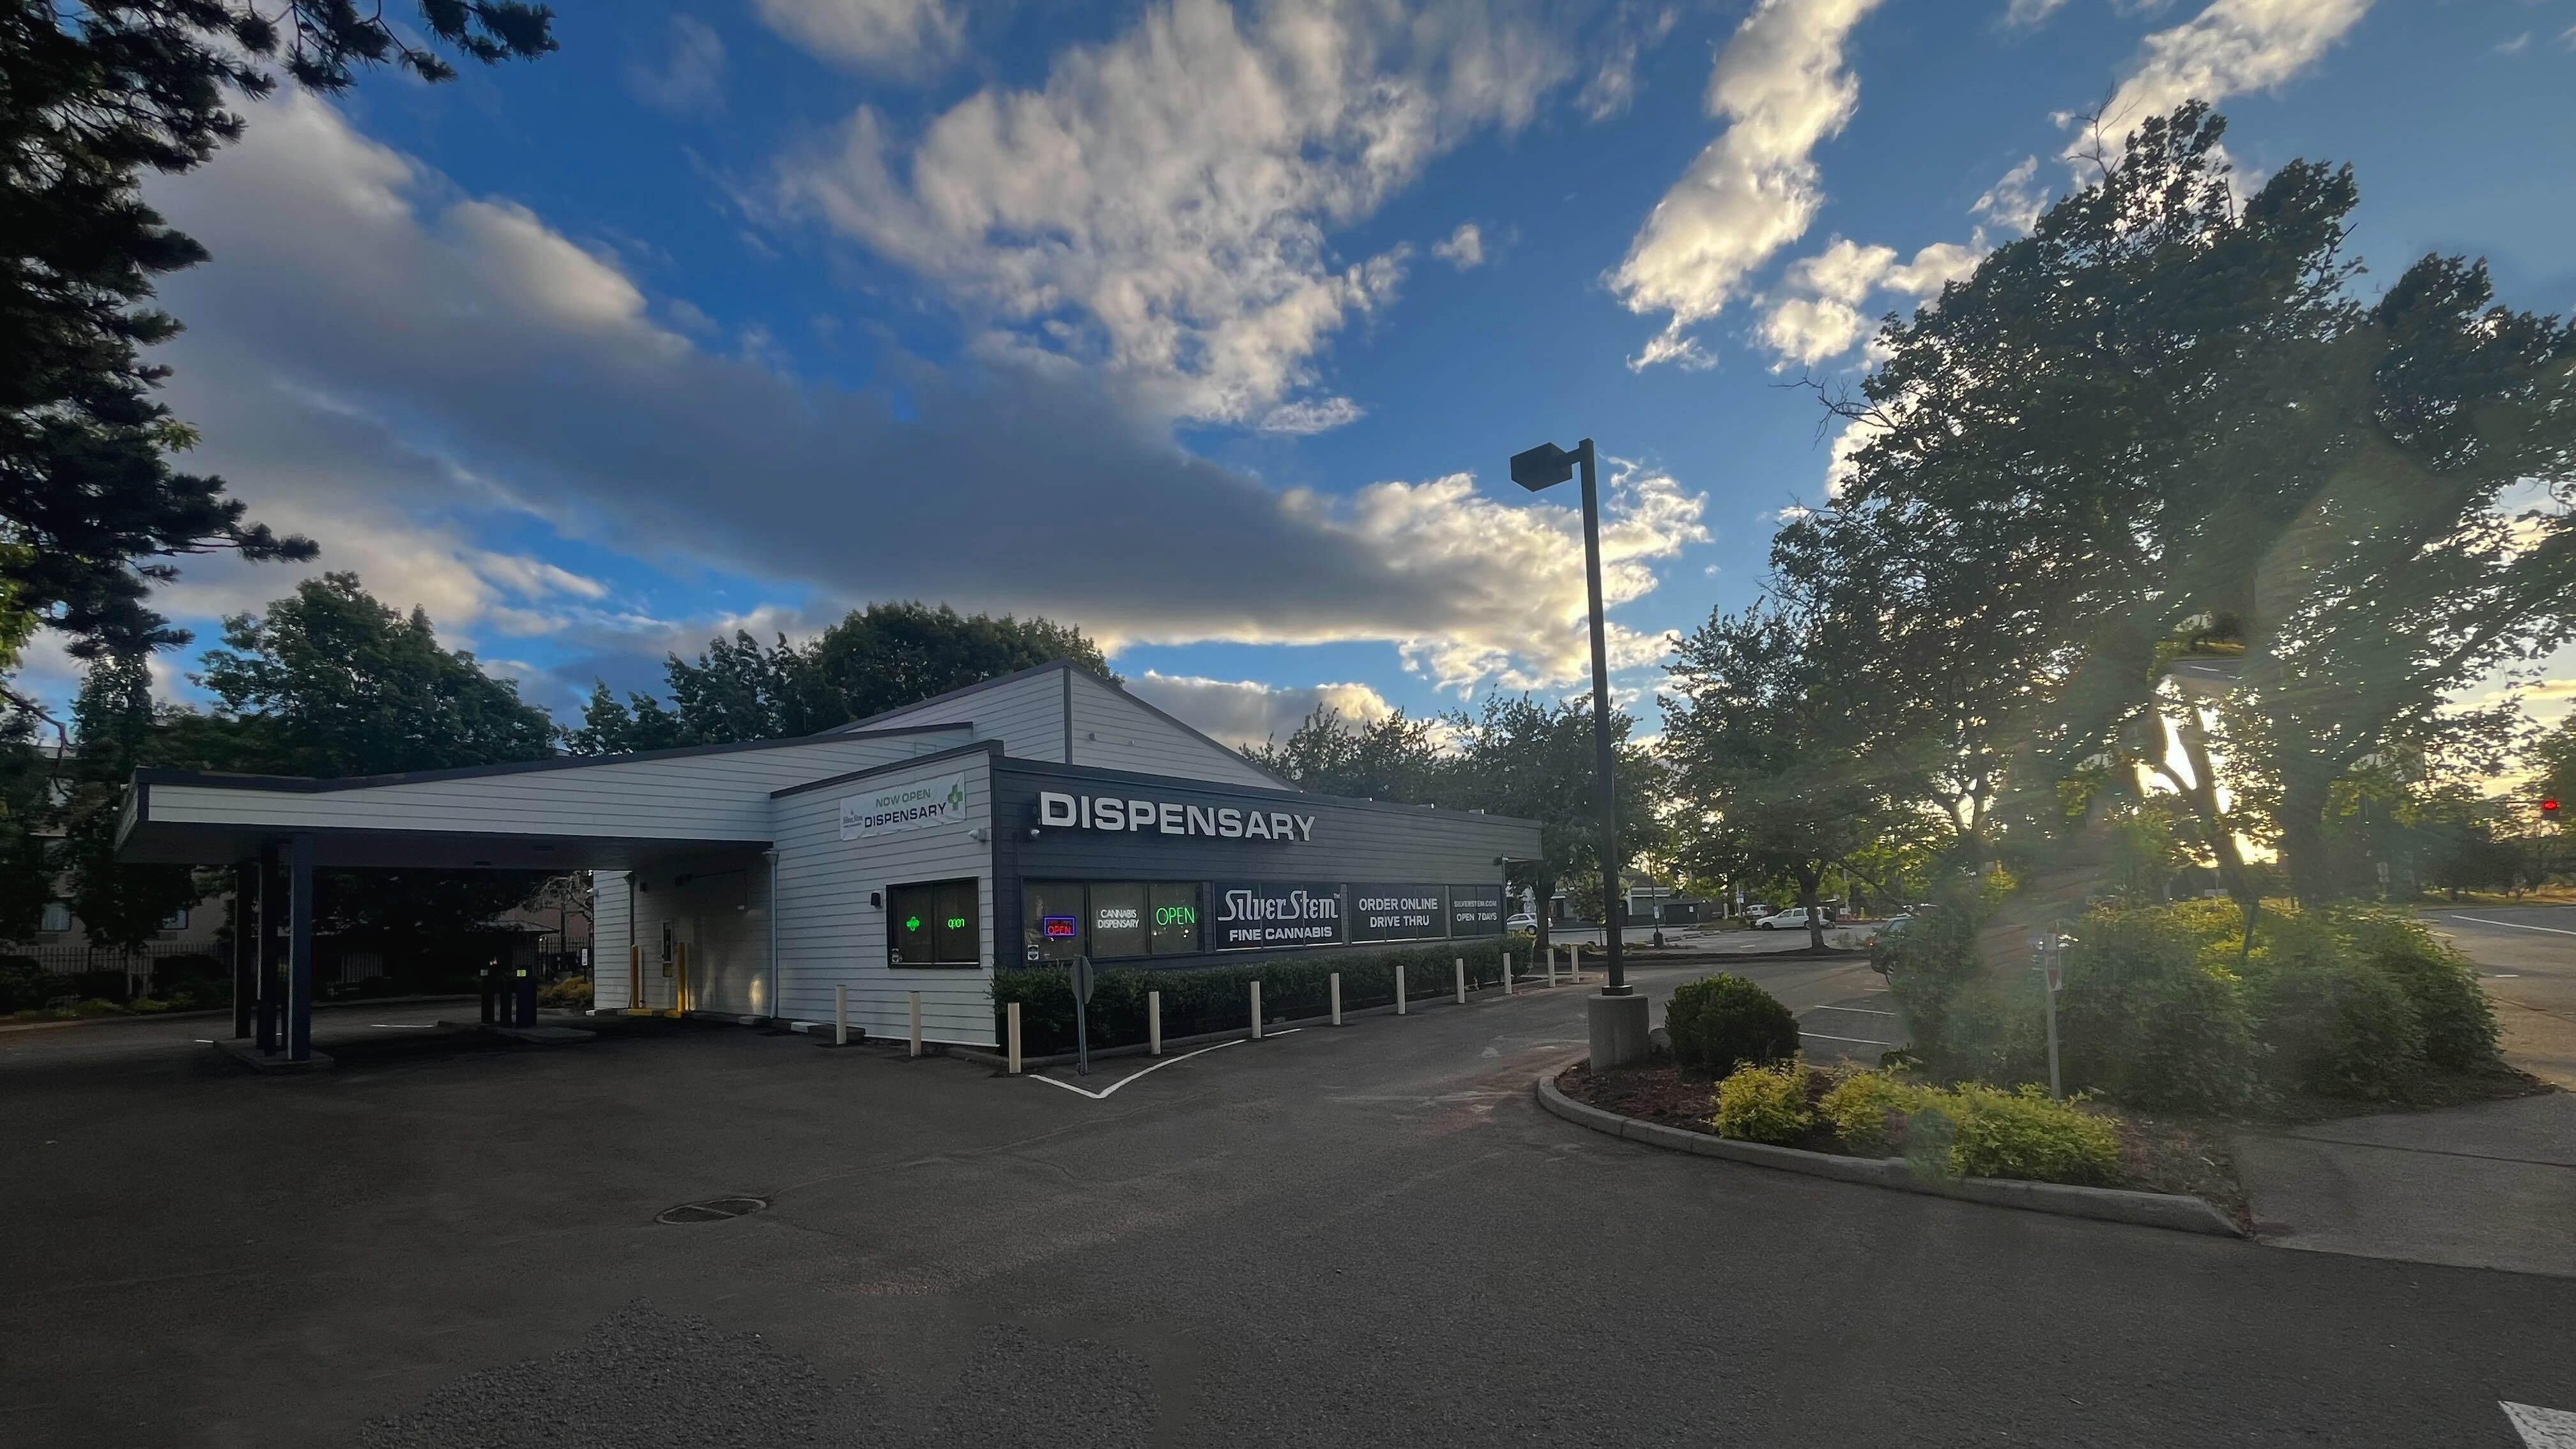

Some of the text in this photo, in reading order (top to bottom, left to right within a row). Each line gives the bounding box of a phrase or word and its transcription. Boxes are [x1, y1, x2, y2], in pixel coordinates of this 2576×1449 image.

[875, 788, 931, 808] NOW OPEN
[864, 802, 947, 829] DISPENSARY
[1039, 791, 1315, 841] DISPENSARY
[1217, 889, 1287, 921] Silver
[1277, 890, 1338, 920] Stem
[1358, 898, 1438, 911] ORDER ONLINE
[1100, 908, 1137, 918] CANNABIS
[1155, 906, 1195, 926] OPEN
[1457, 912, 1497, 921] OPEN 7 DAYS
[1098, 919, 1139, 928] DISPENSARY
[1370, 915, 1430, 928] DRIVE THRU
[1047, 925, 1071, 935] OPEN
[1229, 926, 1333, 942] FINE CANNABIS
